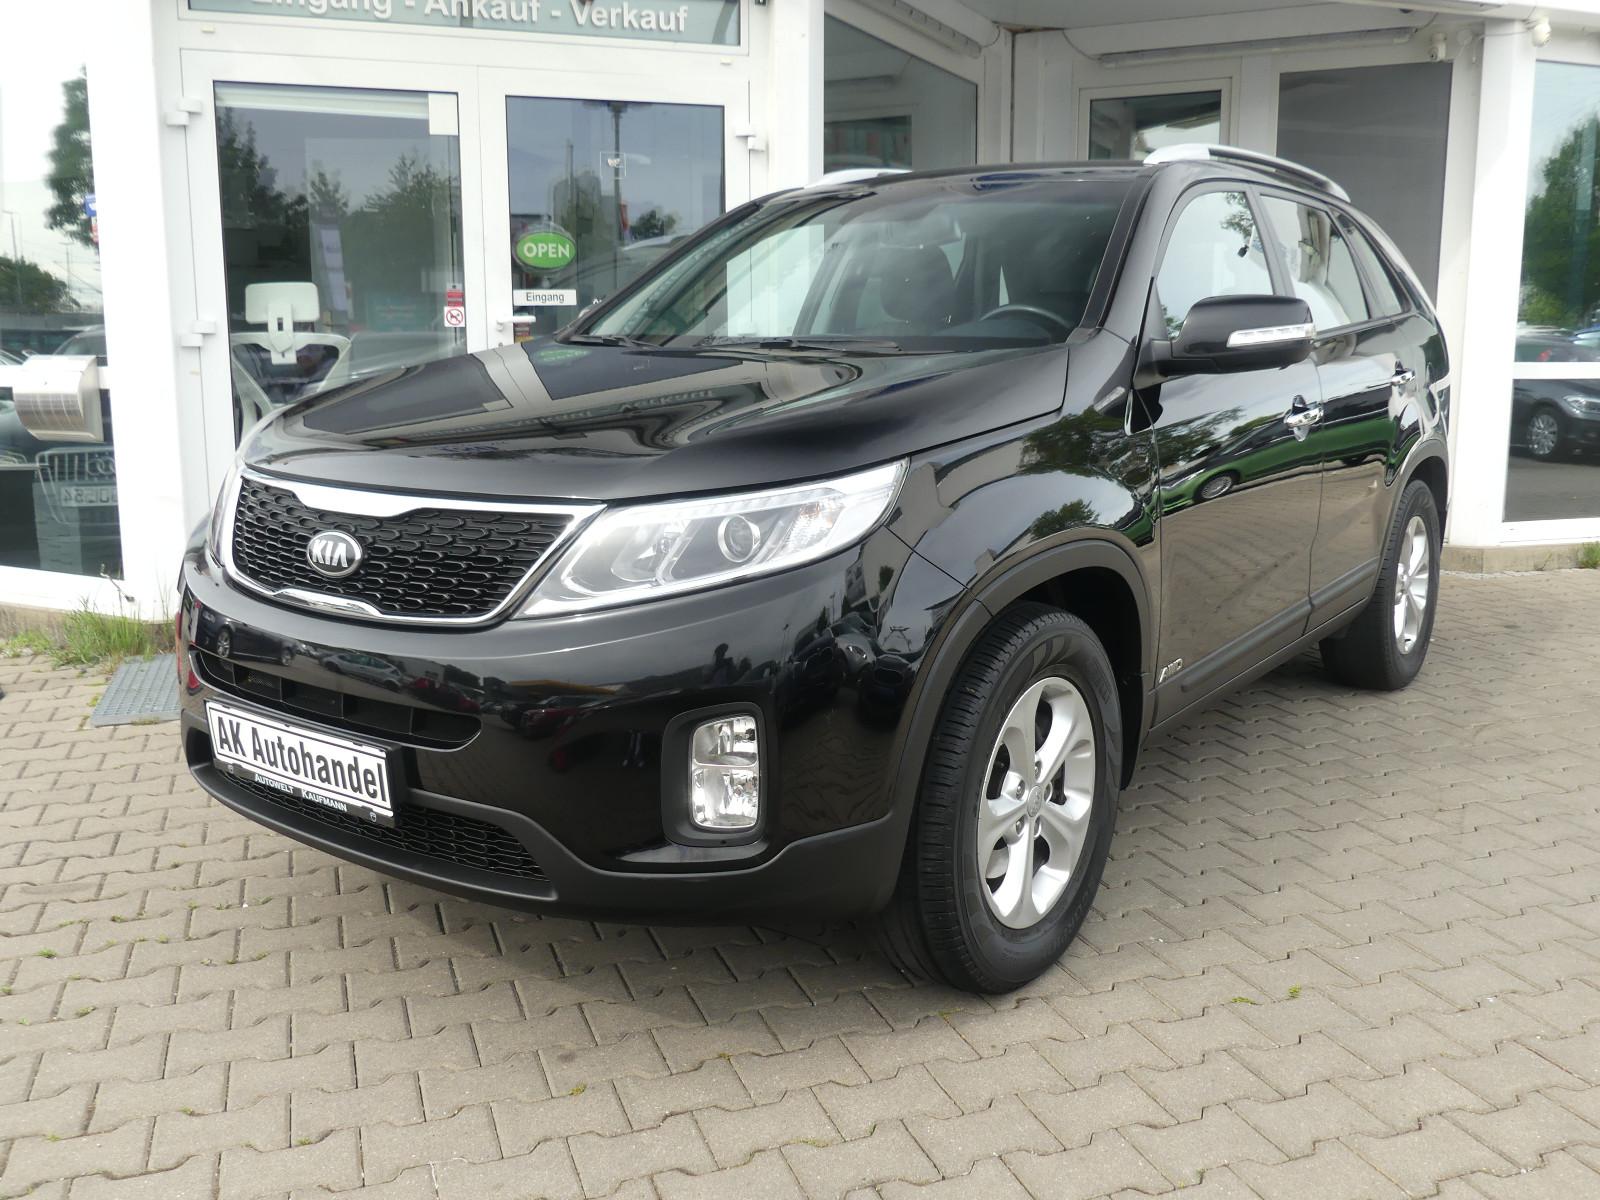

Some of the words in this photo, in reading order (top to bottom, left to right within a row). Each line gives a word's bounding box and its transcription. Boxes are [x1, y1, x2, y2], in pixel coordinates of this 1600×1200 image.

[570, 0, 688, 32] Verkauf
[523, 242, 570, 259] OPEN
[526, 292, 565, 303] Eingang
[312, 538, 349, 568] KIA
[217, 716, 247, 758] AK
[251, 726, 387, 802] Autohandel
[254, 773, 294, 794] AUTOWELT
[301, 788, 348, 812] KAUFMANN
